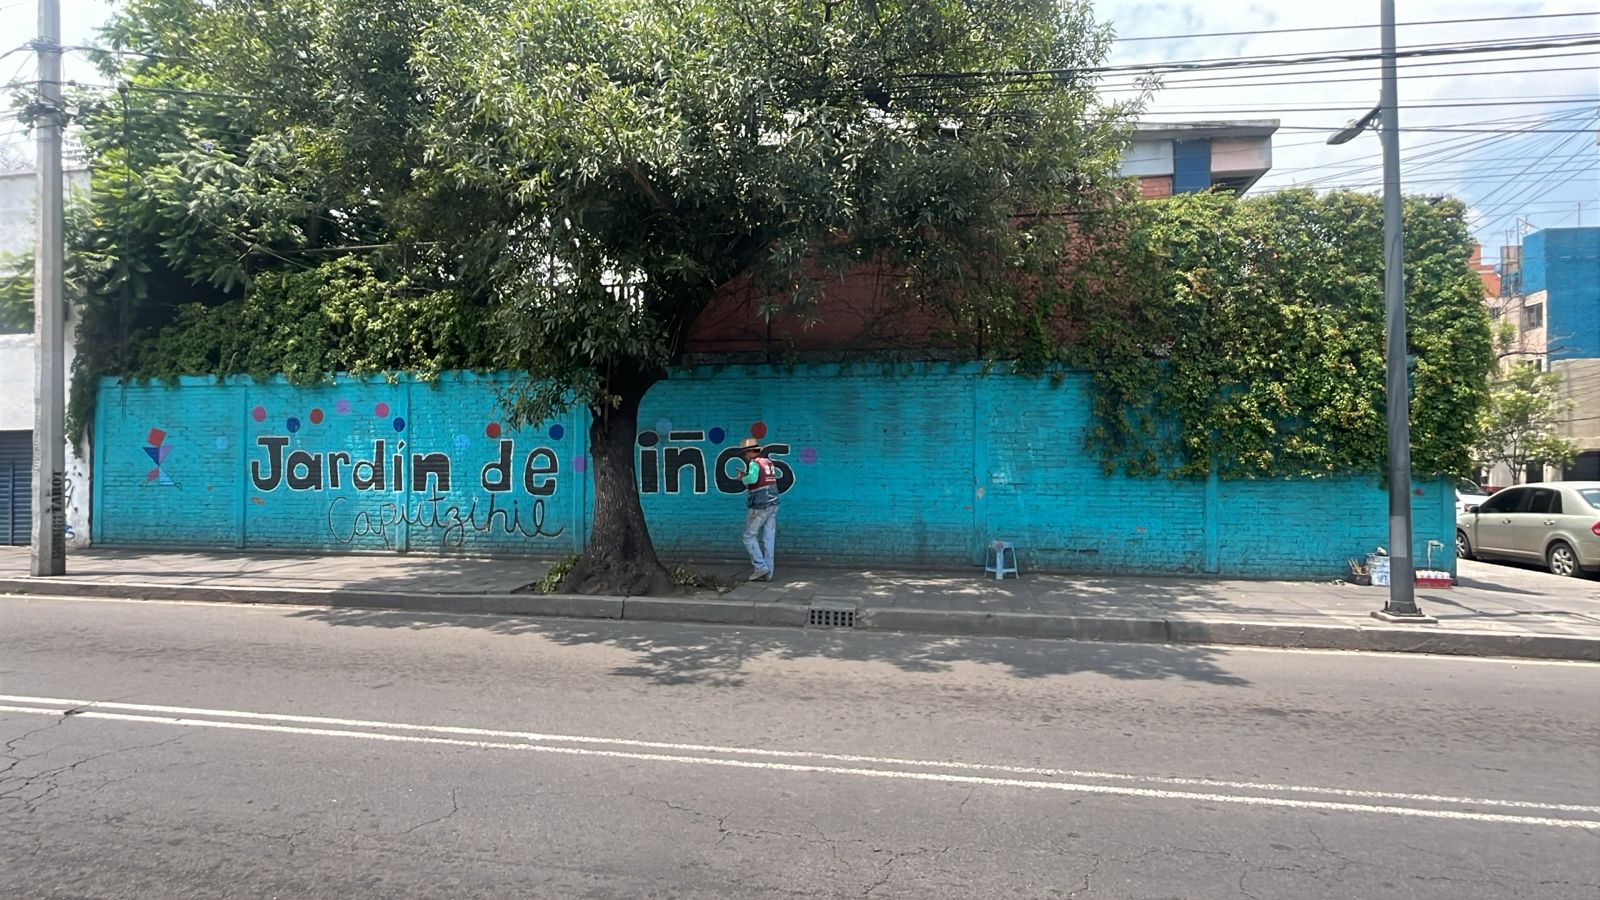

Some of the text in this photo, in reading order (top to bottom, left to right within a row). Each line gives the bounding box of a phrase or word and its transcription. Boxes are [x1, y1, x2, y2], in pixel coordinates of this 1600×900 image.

[51, 469, 63, 514] TAROT
[251, 430, 796, 497] Jardín de iños
